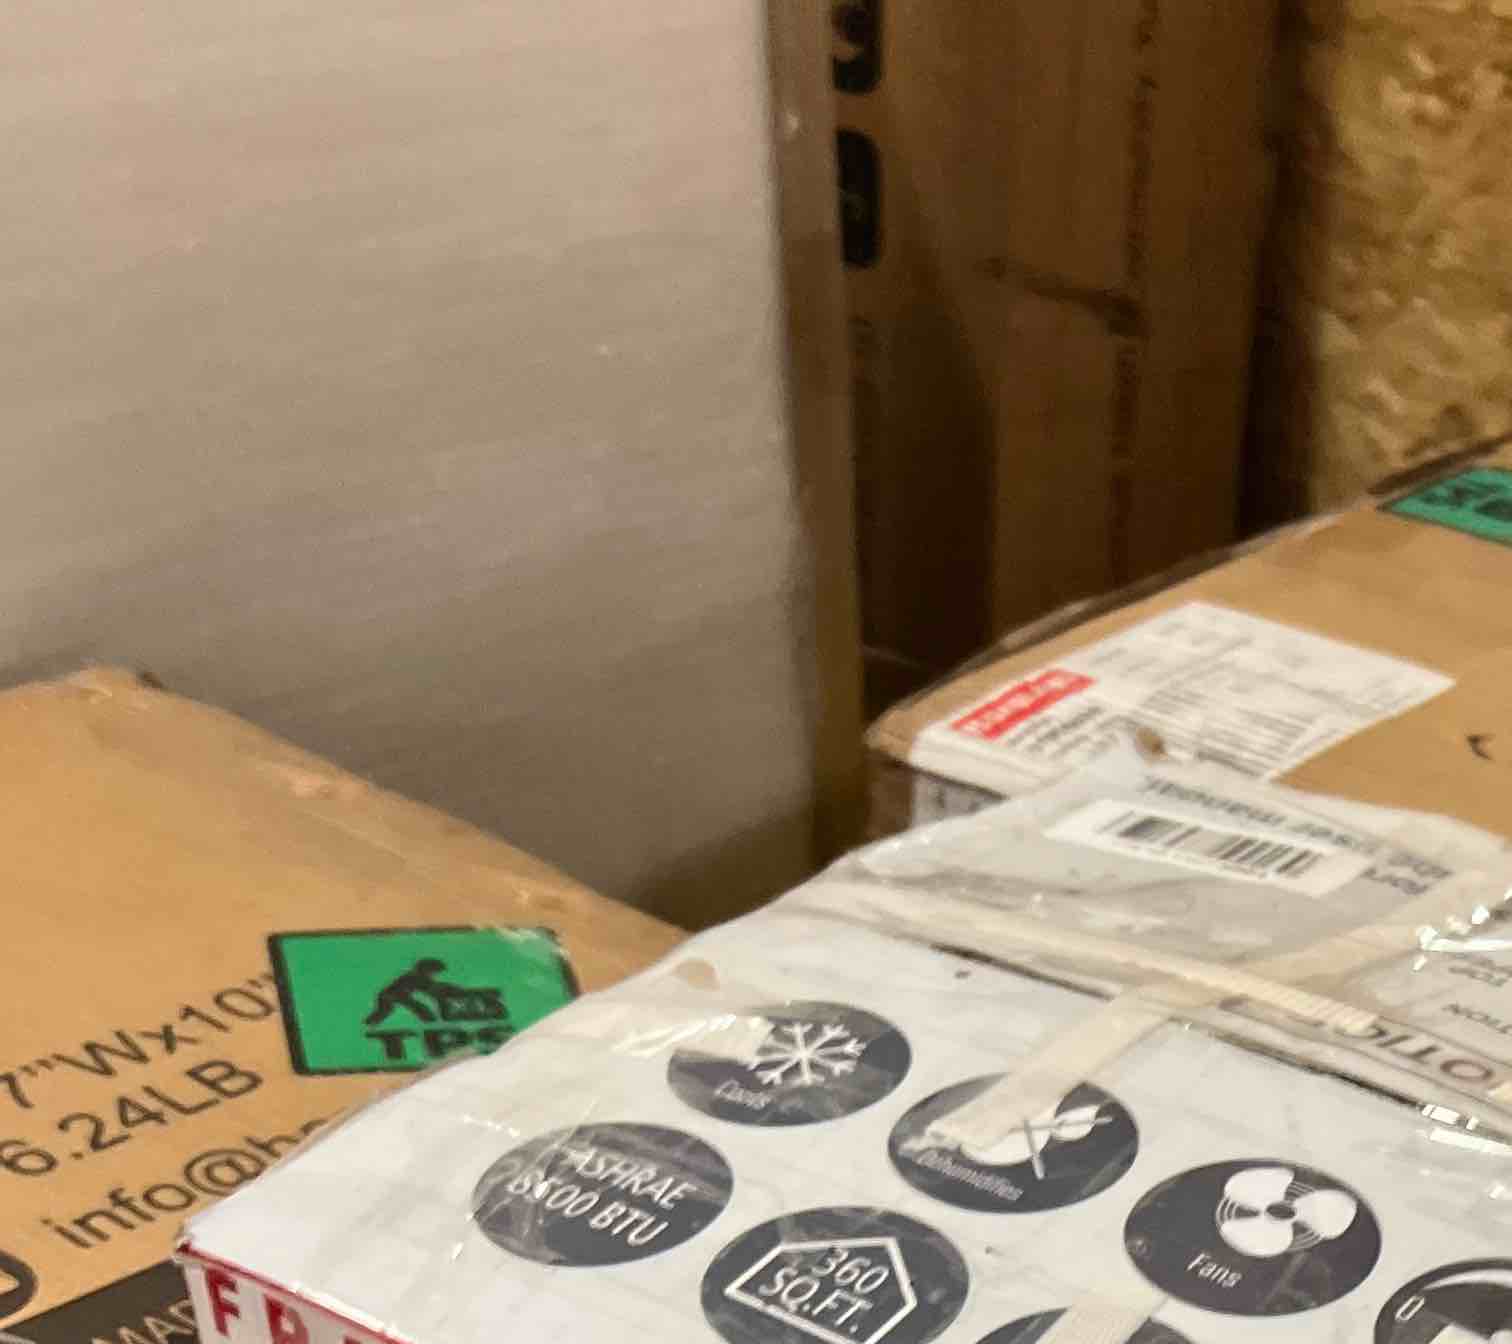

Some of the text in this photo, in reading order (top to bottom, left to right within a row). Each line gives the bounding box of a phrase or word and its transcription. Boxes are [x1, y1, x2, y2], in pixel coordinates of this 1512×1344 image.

[570, 1146, 698, 1210] ASHRAE
[589, 1200, 671, 1247] BTU
[757, 1264, 875, 1334] SQ.FT.
[810, 1246, 891, 1297] 360
